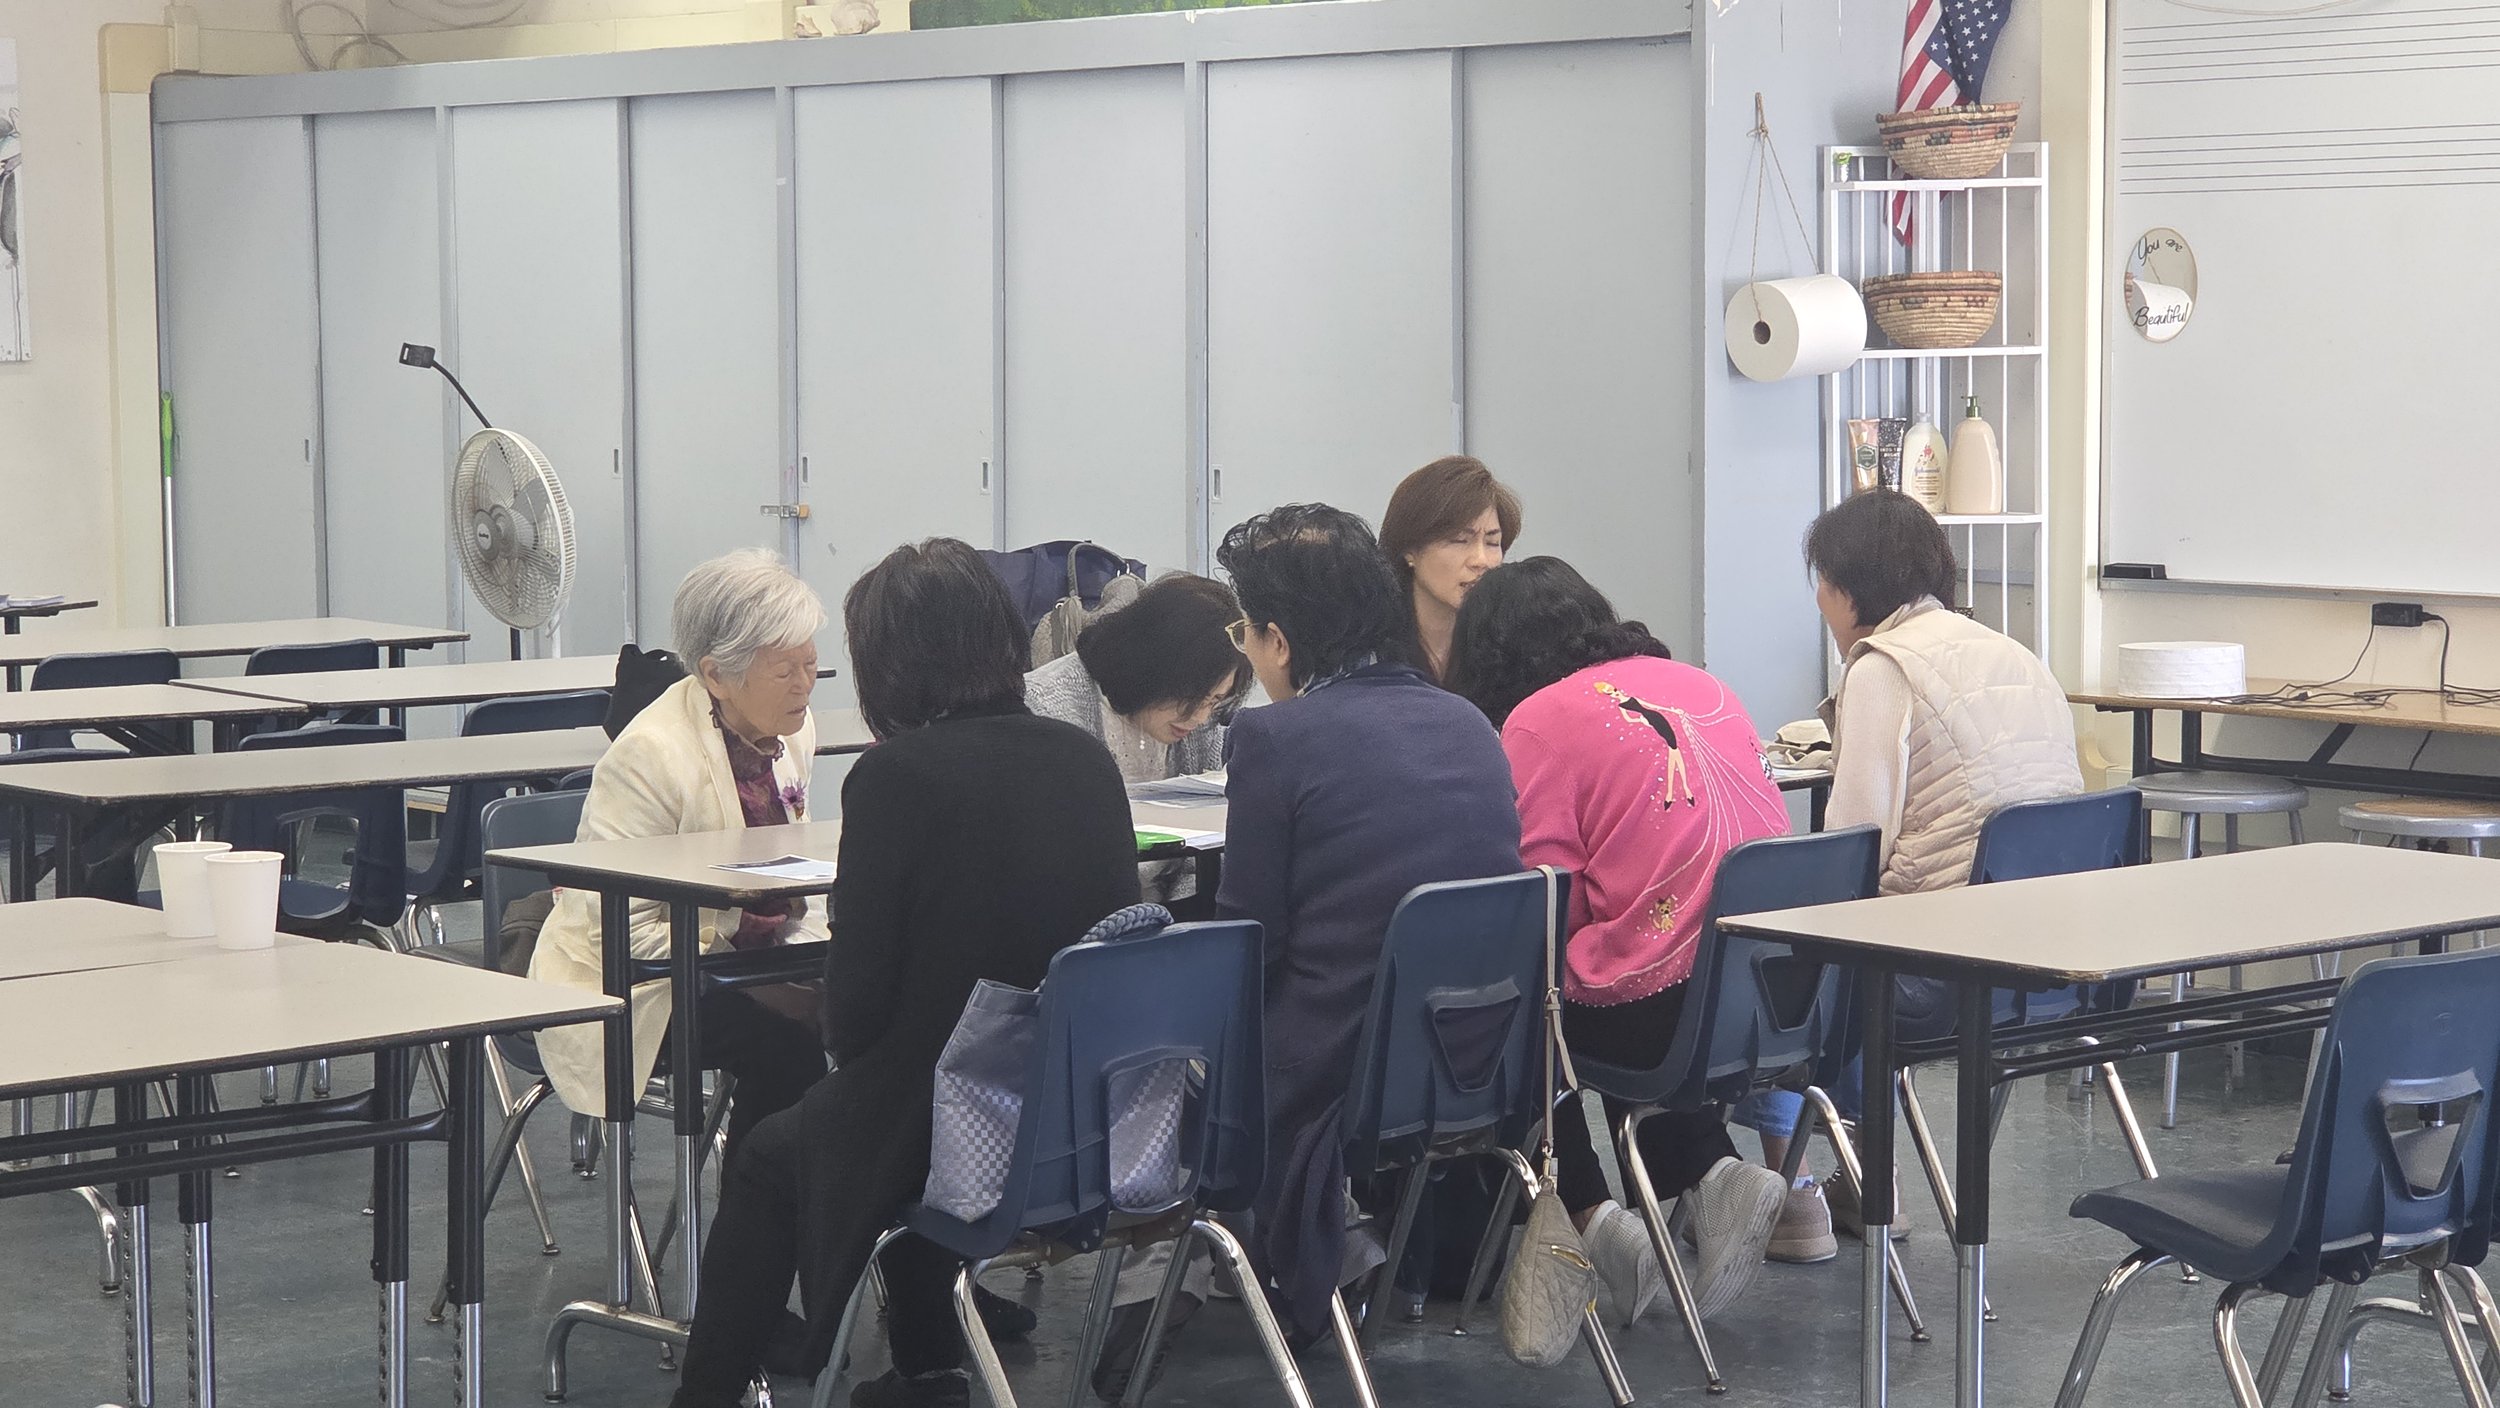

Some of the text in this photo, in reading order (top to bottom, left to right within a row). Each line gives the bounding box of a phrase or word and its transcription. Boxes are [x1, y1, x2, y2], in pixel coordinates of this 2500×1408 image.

[2137, 236, 2183, 267] You are
[2133, 303, 2190, 327] Beautiful
